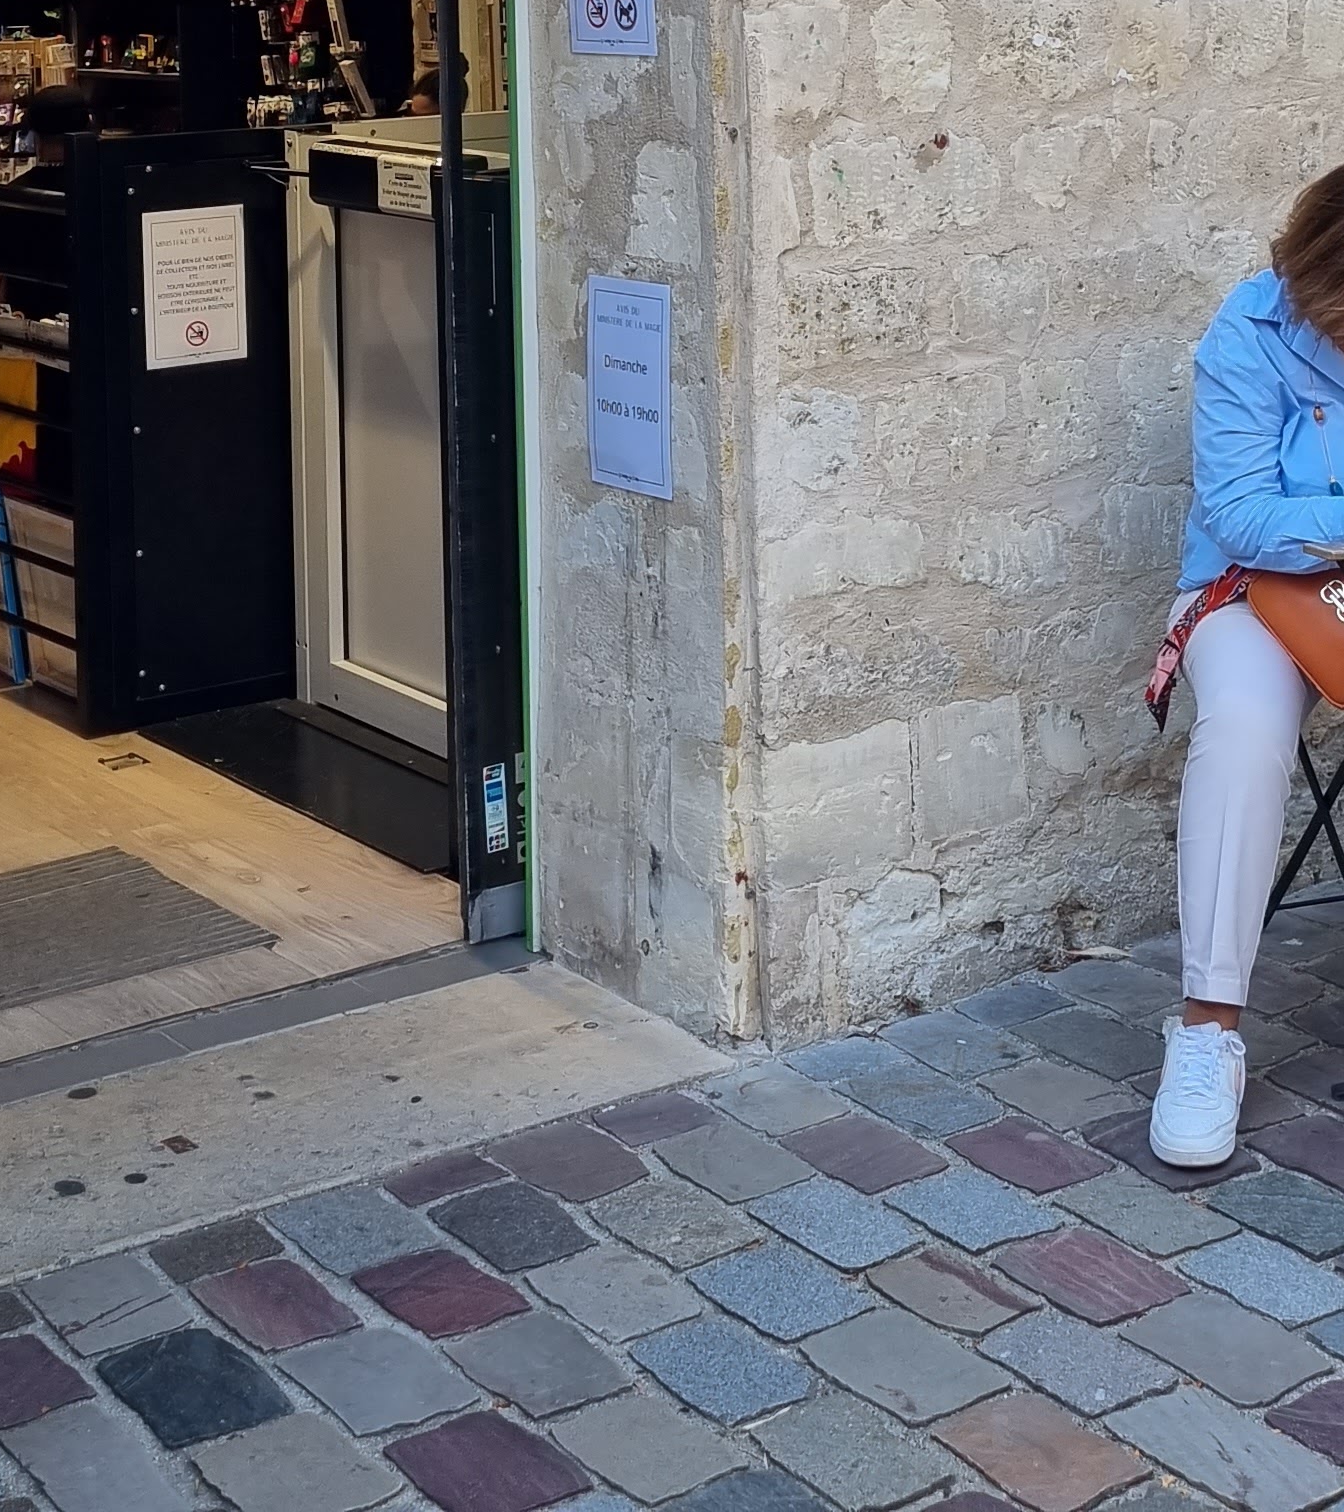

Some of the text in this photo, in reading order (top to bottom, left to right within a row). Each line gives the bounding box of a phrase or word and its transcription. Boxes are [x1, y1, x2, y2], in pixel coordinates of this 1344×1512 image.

[604, 354, 648, 376] Dimanche
[596, 398, 659, 424] 10h00 à 19h00
